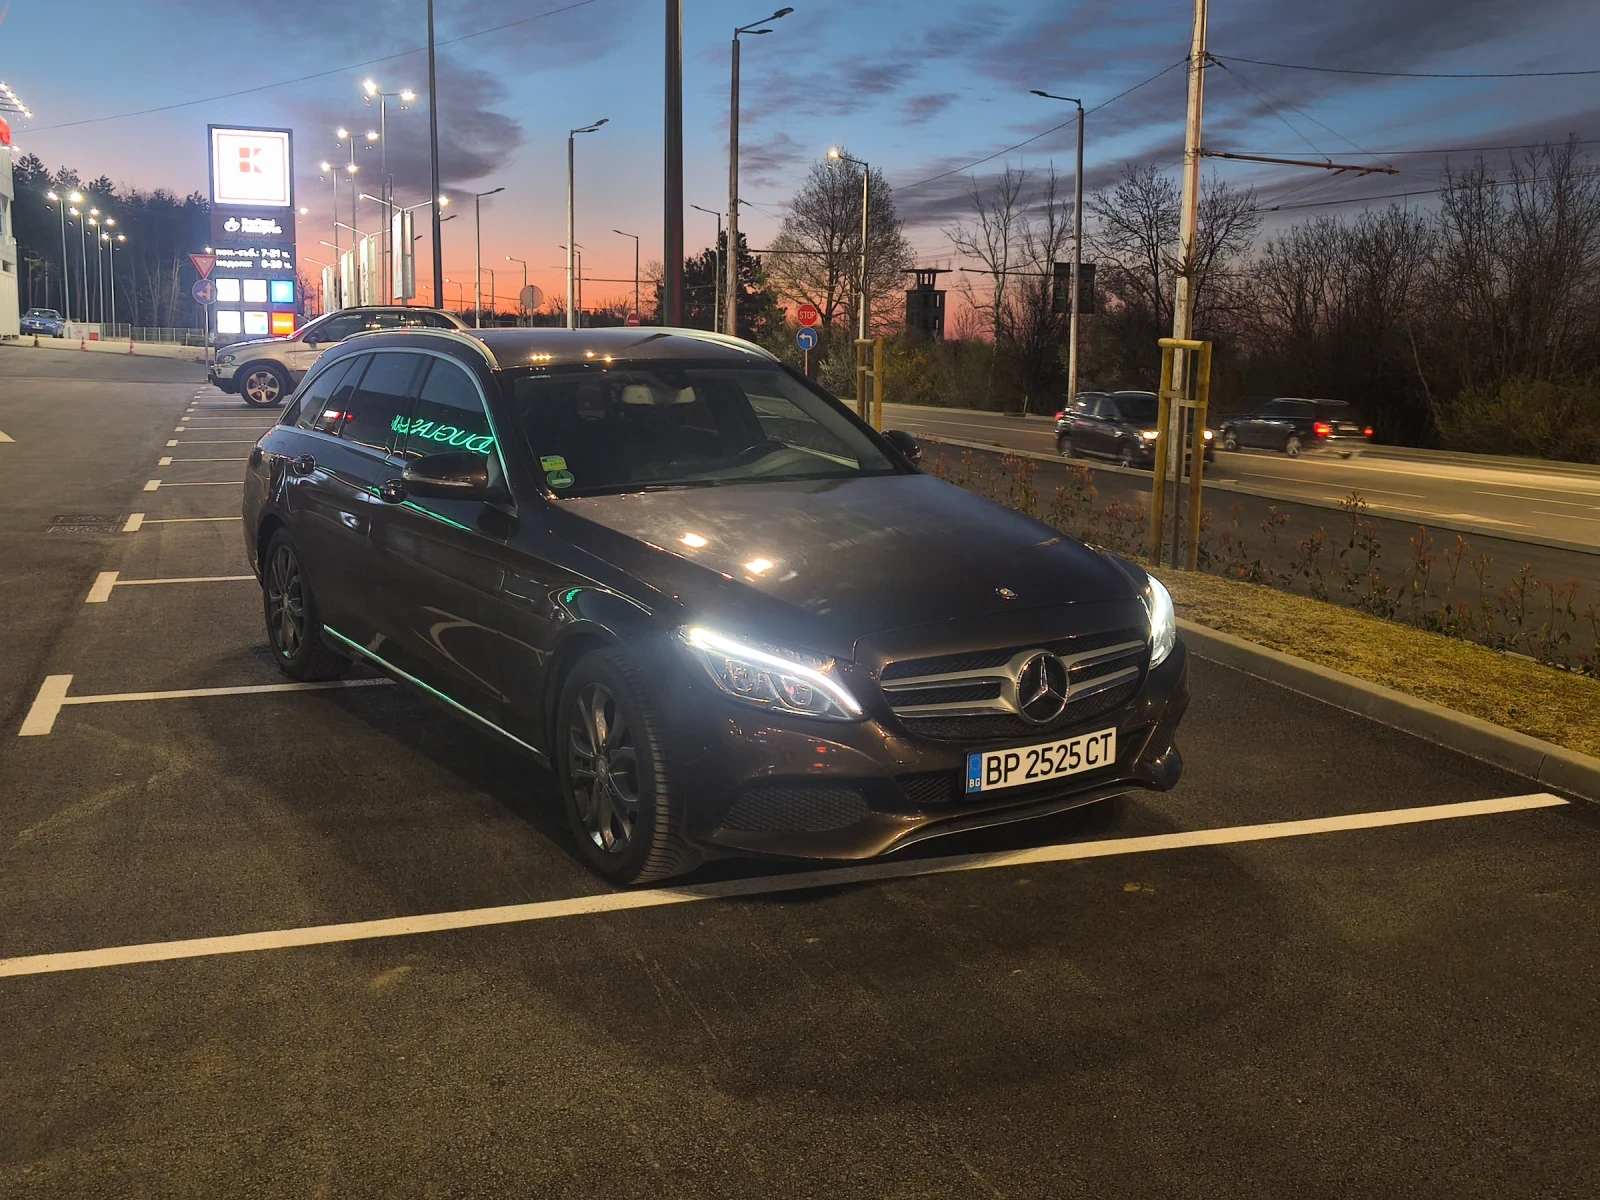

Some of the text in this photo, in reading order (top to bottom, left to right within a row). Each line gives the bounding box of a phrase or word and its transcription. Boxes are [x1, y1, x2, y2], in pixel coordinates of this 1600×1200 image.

[799, 310, 816, 320] STOP
[986, 733, 1113, 785] BP 2525 CT
[969, 778, 981, 788] BG
